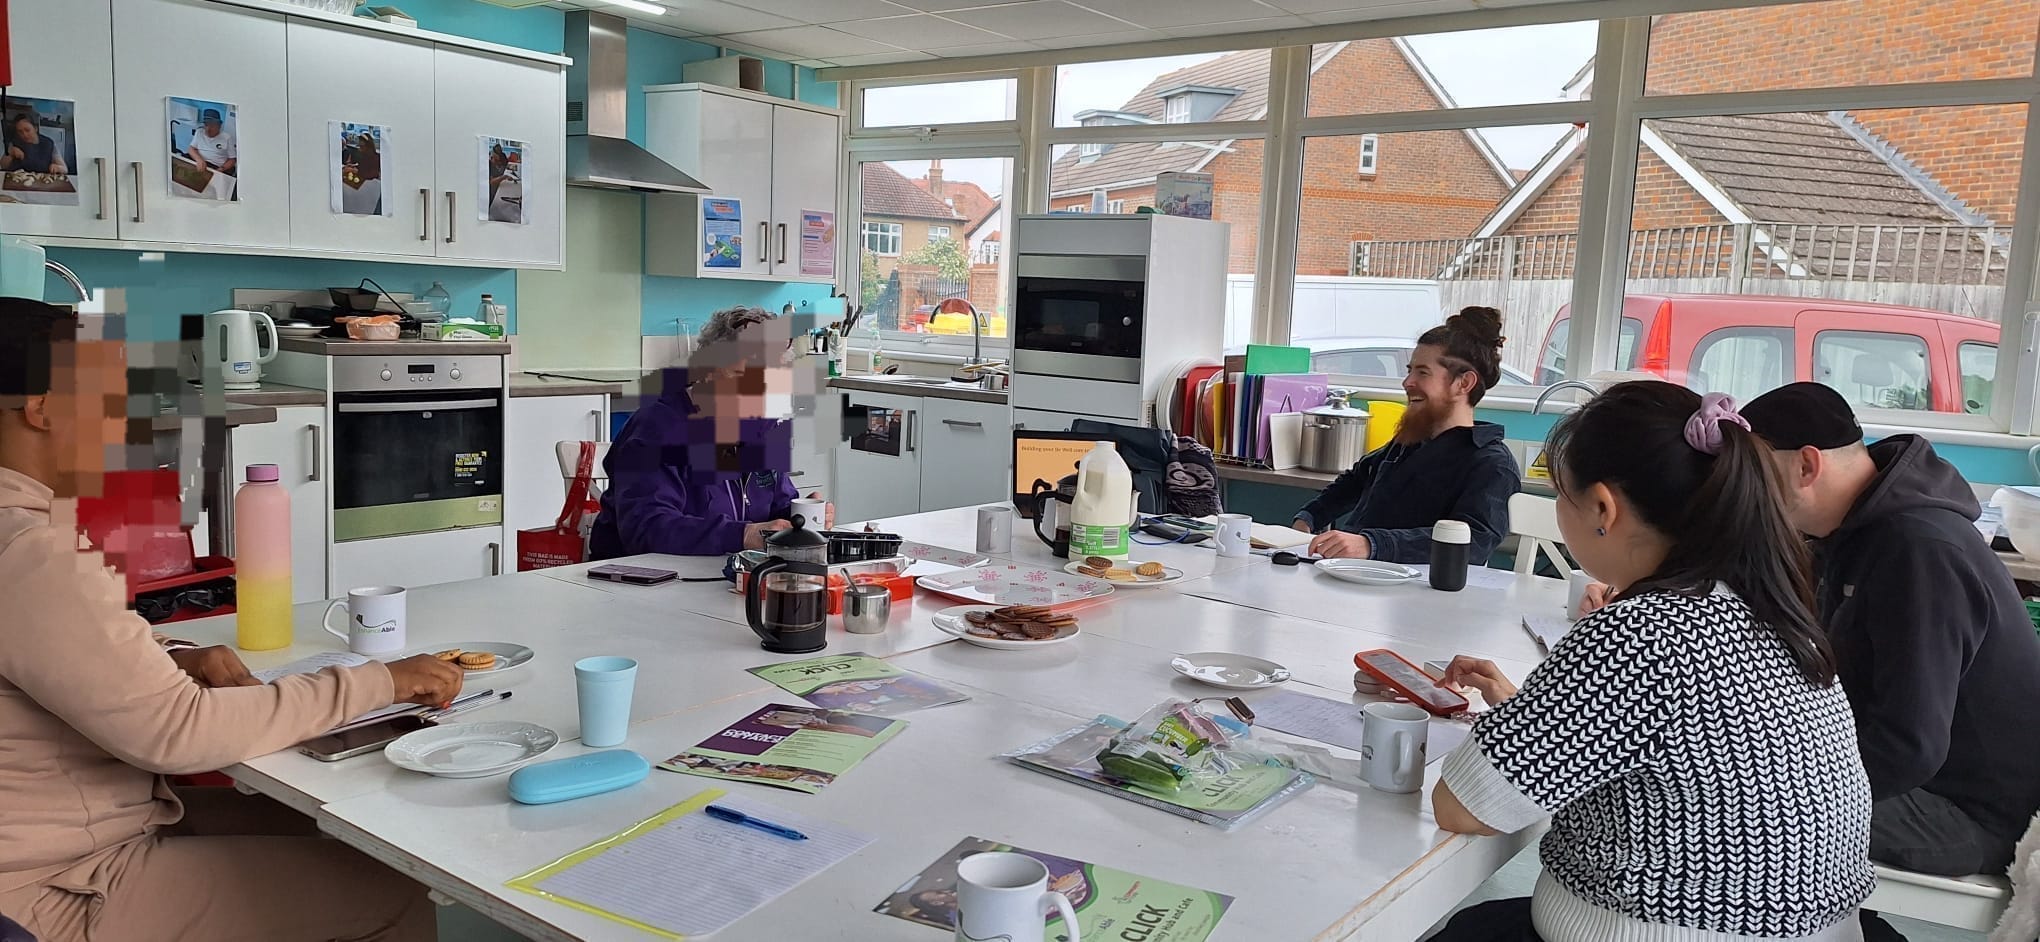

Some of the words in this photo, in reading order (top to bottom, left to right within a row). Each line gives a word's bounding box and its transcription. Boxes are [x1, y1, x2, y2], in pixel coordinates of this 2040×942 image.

[1021, 445, 1041, 453] Building
[802, 663, 852, 676] CLICK
[1202, 774, 1245, 797] CLICK
[1178, 897, 1194, 910] Cafe
[1120, 904, 1170, 942] CLICK
